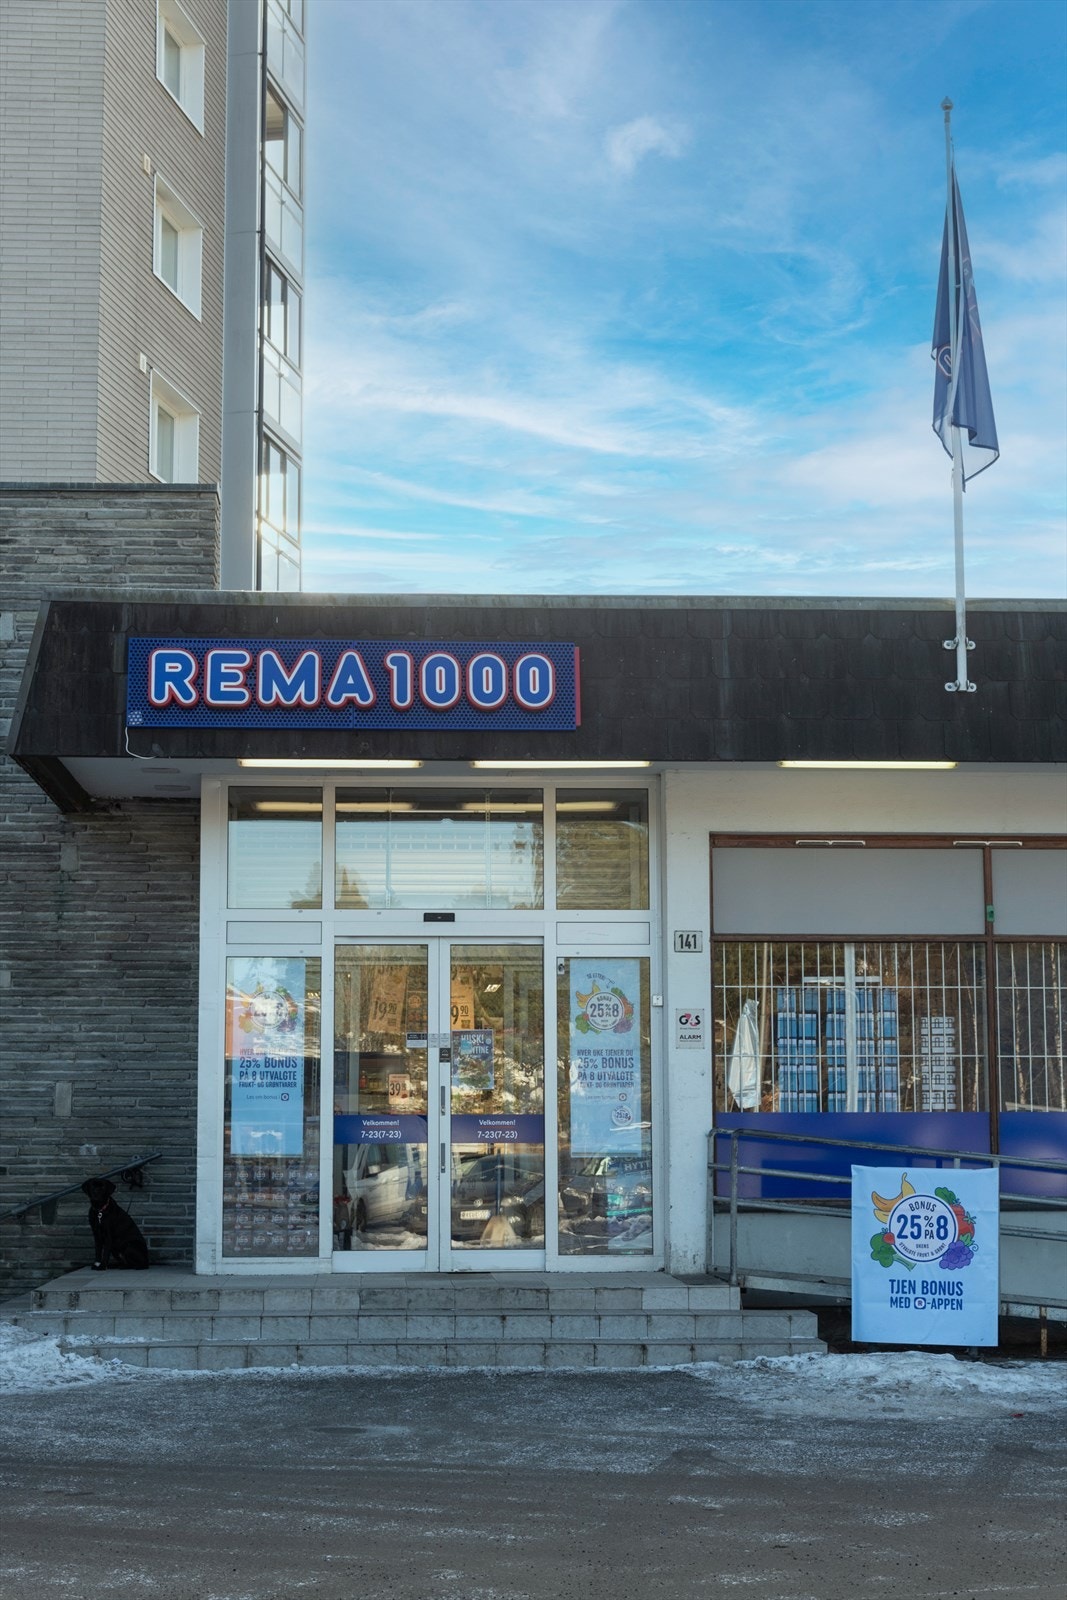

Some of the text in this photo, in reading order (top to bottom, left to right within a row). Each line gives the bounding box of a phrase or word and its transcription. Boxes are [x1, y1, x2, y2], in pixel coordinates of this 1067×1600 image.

[148, 647, 556, 712] REMA 1000
[678, 934, 697, 950] 141
[590, 1003, 605, 1018] 25
[612, 1003, 619, 1018] 8
[679, 1013, 701, 1027] G4S
[577, 1049, 634, 1057] HVER UKE TJENER DU
[240, 1056, 297, 1069] 25% BONUS
[578, 1057, 634, 1069] 25% BONUS
[240, 1068, 297, 1081] PÅ 8 UTVALGTE
[578, 1069, 634, 1081] PÅ 8 UTVALGTE
[390, 1083, 401, 1096] 39
[361, 1130, 402, 1139] 7-23(7-23)
[477, 1130, 518, 1139] 7-23(7-23)
[908, 1200, 937, 1213] BONUS
[896, 1214, 922, 1240] 25
[936, 1214, 949, 1241] 8
[889, 1279, 964, 1297] TJEN BONUS
[890, 1297, 911, 1309] MED
